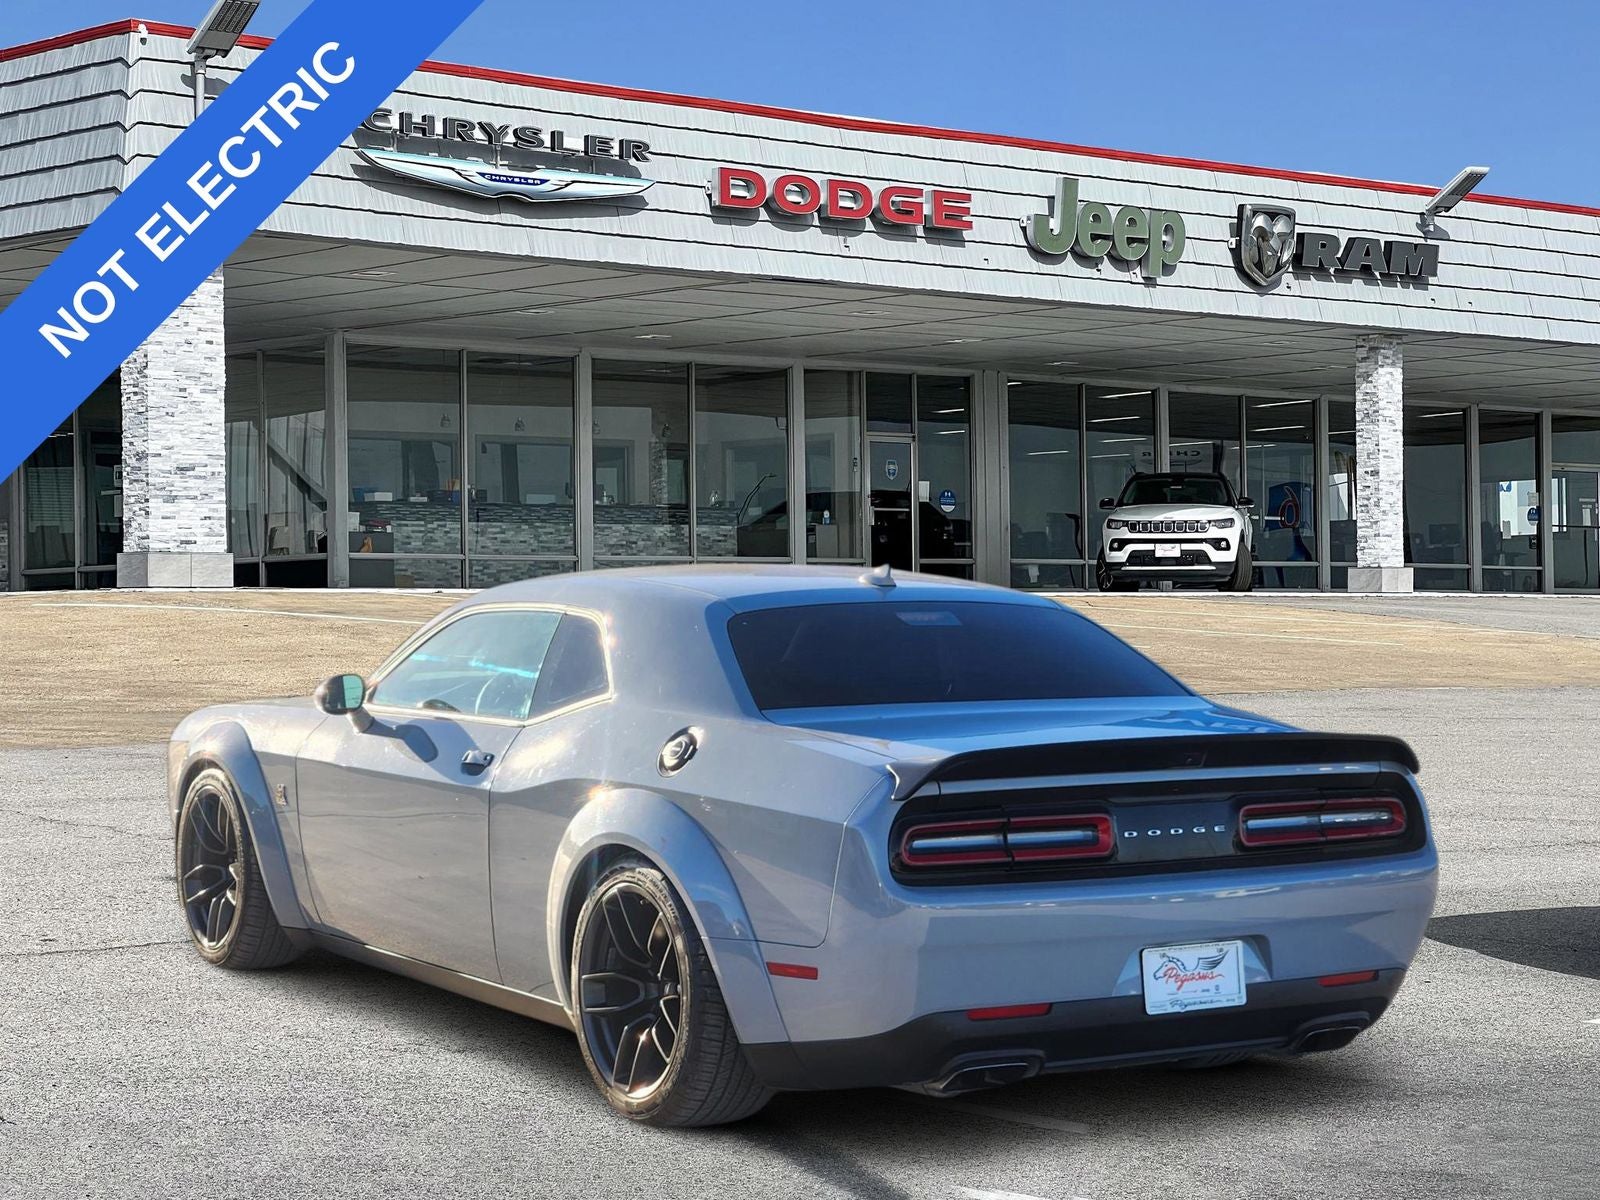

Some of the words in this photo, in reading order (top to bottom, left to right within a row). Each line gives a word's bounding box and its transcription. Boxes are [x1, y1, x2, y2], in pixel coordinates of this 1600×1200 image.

[361, 108, 651, 162] CHRYSLER
[484, 174, 541, 184] CHRYSLER
[711, 166, 973, 231] DODGE
[1027, 177, 1186, 278] Jeep
[1299, 232, 1439, 277] RAM
[1124, 824, 1225, 838] DODGE
[1163, 966, 1225, 992] Pegasus
